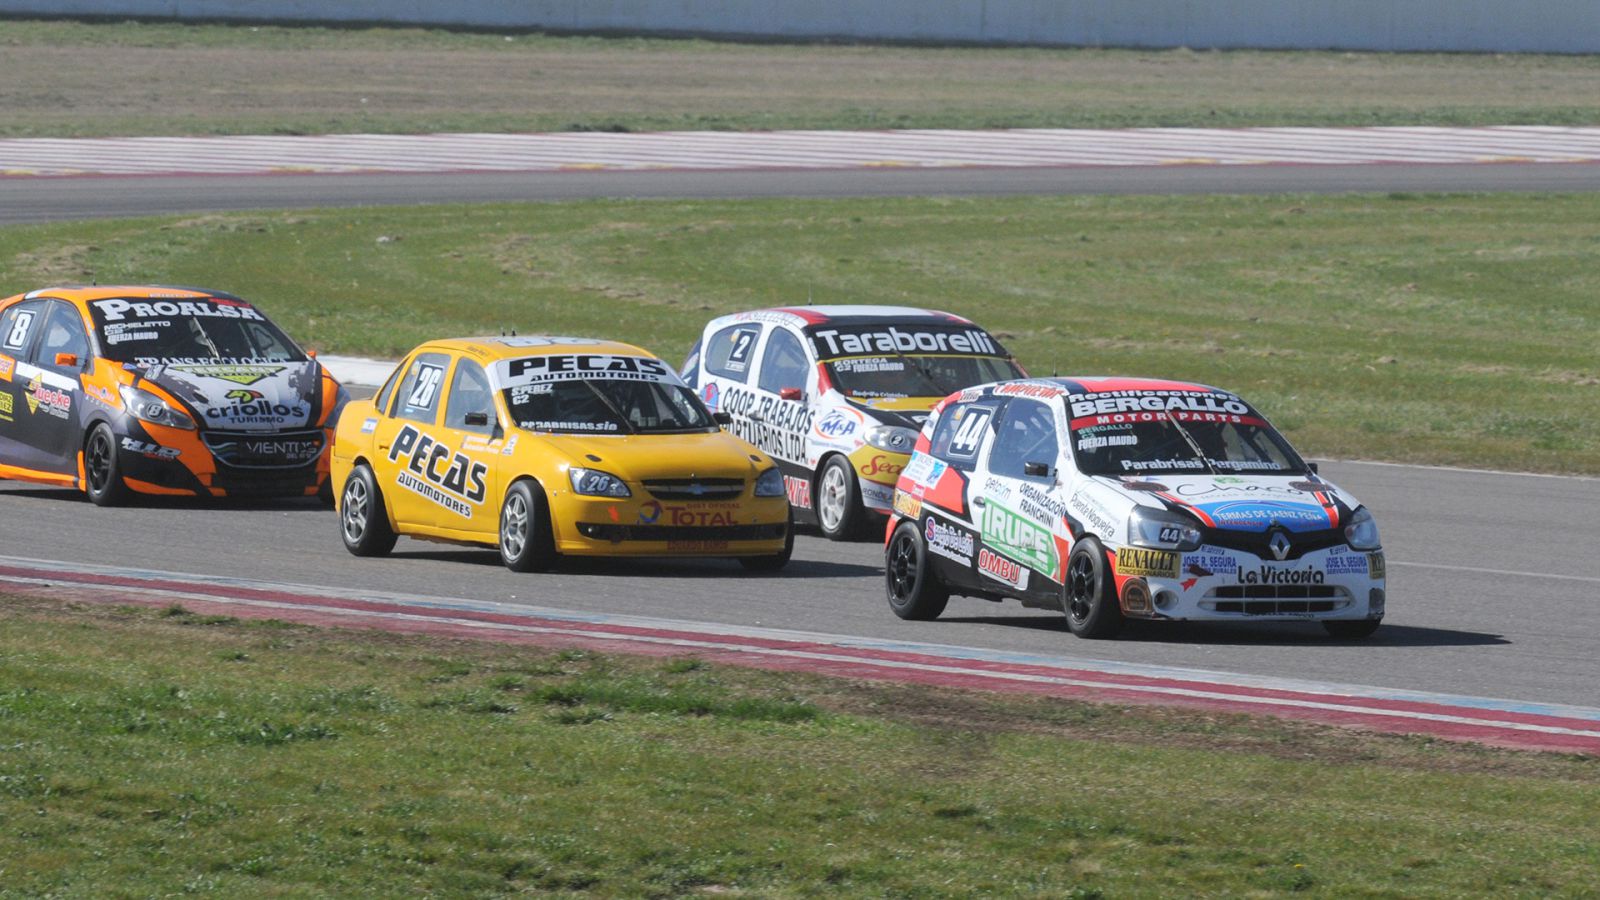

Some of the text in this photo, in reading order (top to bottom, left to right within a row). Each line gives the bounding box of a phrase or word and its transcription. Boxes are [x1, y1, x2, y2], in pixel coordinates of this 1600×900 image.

[92, 299, 265, 321] PROALSA
[8, 313, 32, 347] 8
[133, 331, 159, 340] MAURO
[733, 335, 751, 358] 2
[816, 327, 996, 354] Taraborelli
[509, 355, 667, 378] PECAS
[530, 372, 659, 382] AUTOMOTORES
[407, 366, 442, 408] 26
[1069, 390, 1239, 403] Rectificaciones
[149, 405, 162, 417] 8
[206, 400, 304, 419] criollos
[760, 396, 815, 435] TRABAJOS
[1071, 397, 1249, 418] BERGALLO
[229, 416, 285, 424] TURISMO
[822, 418, 856, 436] M&A
[1097, 412, 1241, 424] MOTOR PARTS
[953, 412, 989, 451] 44
[1078, 423, 1133, 435] BERGALLO
[892, 434, 904, 446] 2
[1078, 434, 1138, 451] FUERZA MAURO
[388, 424, 488, 503] PECAS
[1121, 459, 1204, 470] Parabrisas
[586, 475, 609, 492] 26
[397, 472, 471, 518] AUTOMOTORES
[665, 506, 738, 526] TOTAL
[1019, 499, 1054, 528] FRANCHINI
[1217, 510, 1254, 520] TERMAS
[1255, 510, 1267, 518] DE
[1268, 510, 1297, 518] SAENZ
[1161, 528, 1178, 542] 44
[980, 550, 1020, 584] OMBU
[1118, 548, 1178, 570] RENAULT
[1209, 557, 1237, 568] SEGURA
[1118, 567, 1177, 578] CONCESIONARIOS
[1238, 564, 1324, 584] La Victoria
